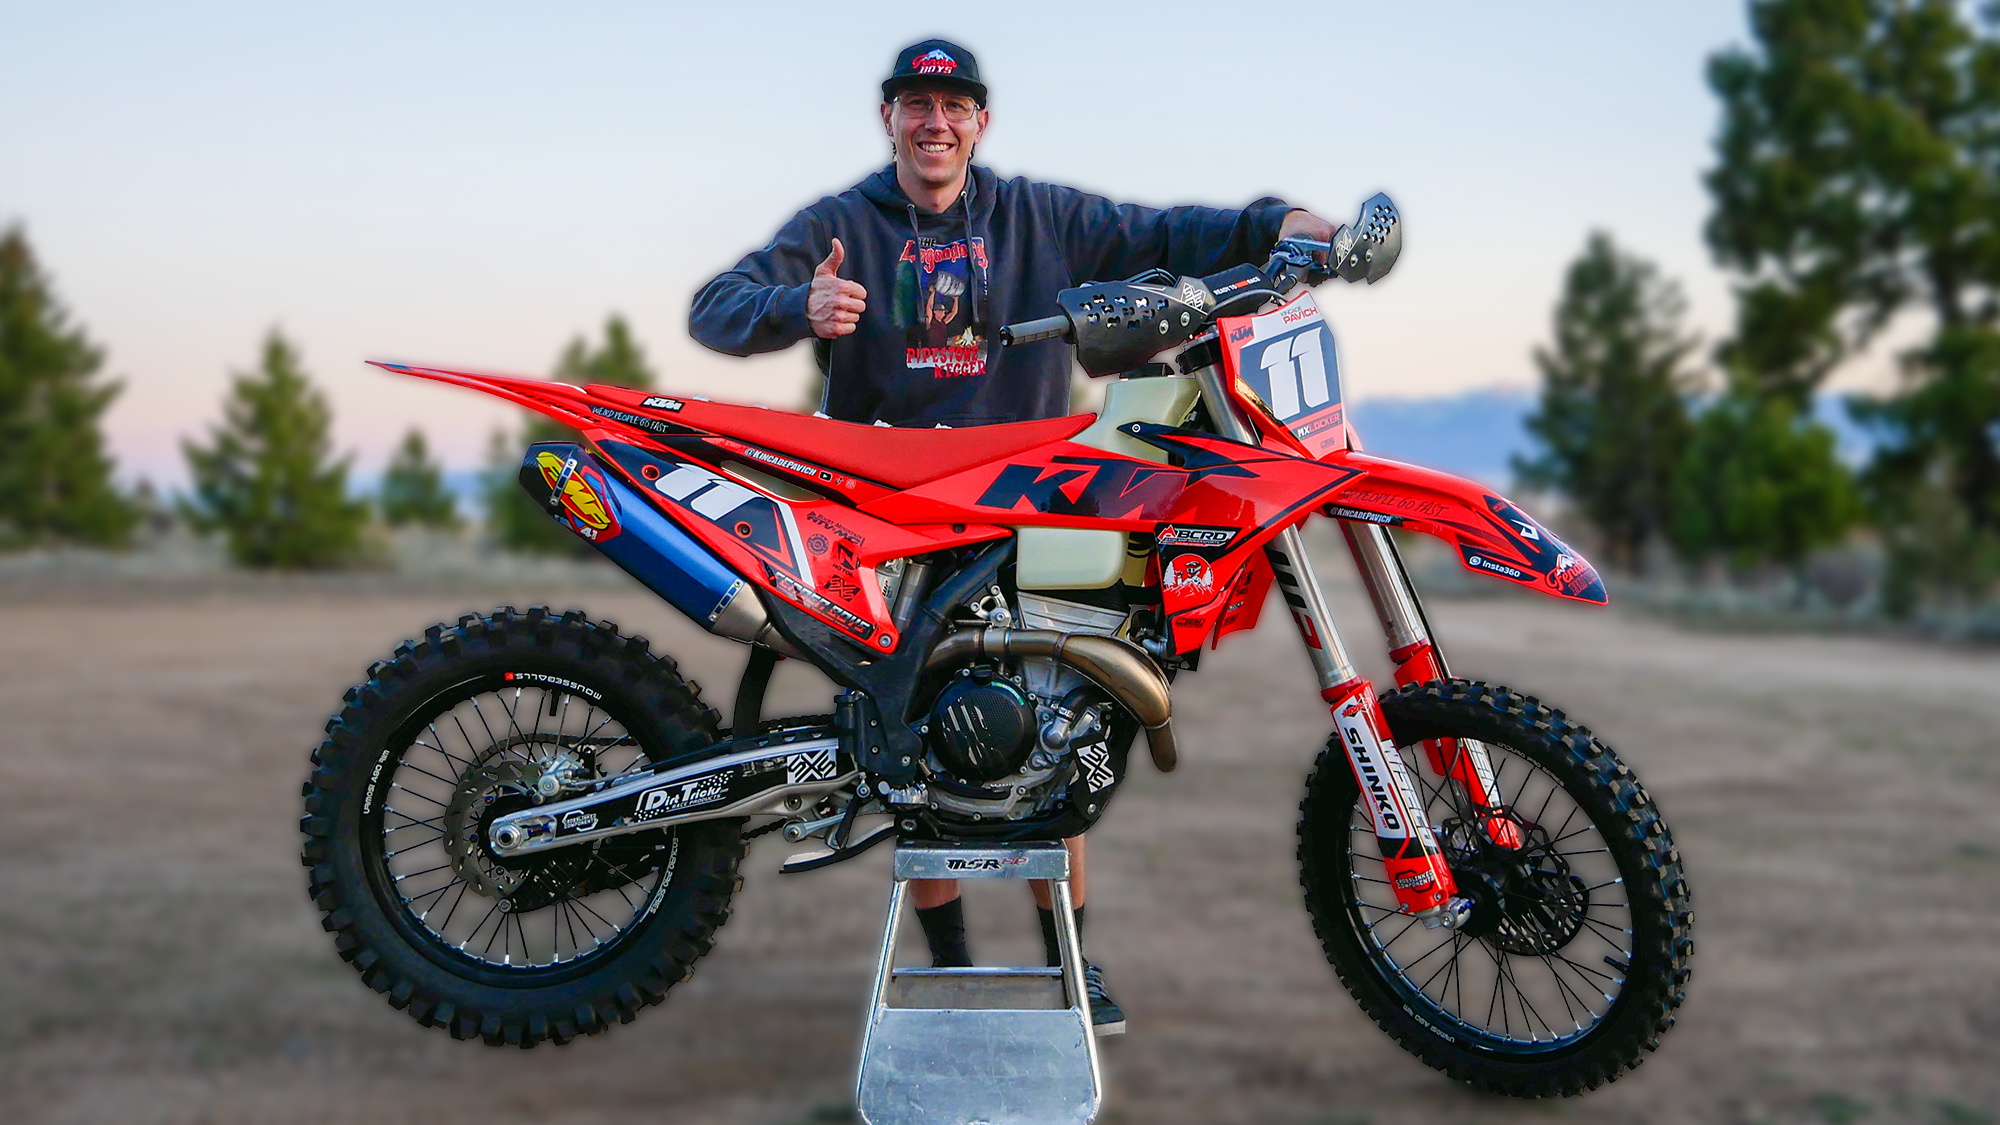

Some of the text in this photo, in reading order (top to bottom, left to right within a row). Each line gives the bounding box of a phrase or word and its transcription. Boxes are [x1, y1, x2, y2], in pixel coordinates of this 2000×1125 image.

[1282, 306, 1319, 325] PAVICH
[1229, 325, 1254, 343] KTM
[906, 345, 980, 364] PIPESTONE
[934, 360, 987, 379] KEGGER
[1260, 326, 1330, 421] 11
[642, 396, 683, 411] KTM
[592, 406, 615, 419] WEIRD
[614, 410, 639, 425] PEOPLE
[639, 418, 650, 428] GO
[1356, 489, 1401, 506] PEOPLE
[1398, 500, 1416, 510] GO
[1482, 560, 1521, 578] Insta360
[828, 604, 871, 634] BOYS
[1344, 727, 1401, 831] SHINKO
[645, 782, 722, 811] Dirt Tricks
[689, 794, 721, 806] PRODUCTS
[946, 858, 1001, 870] MSR
